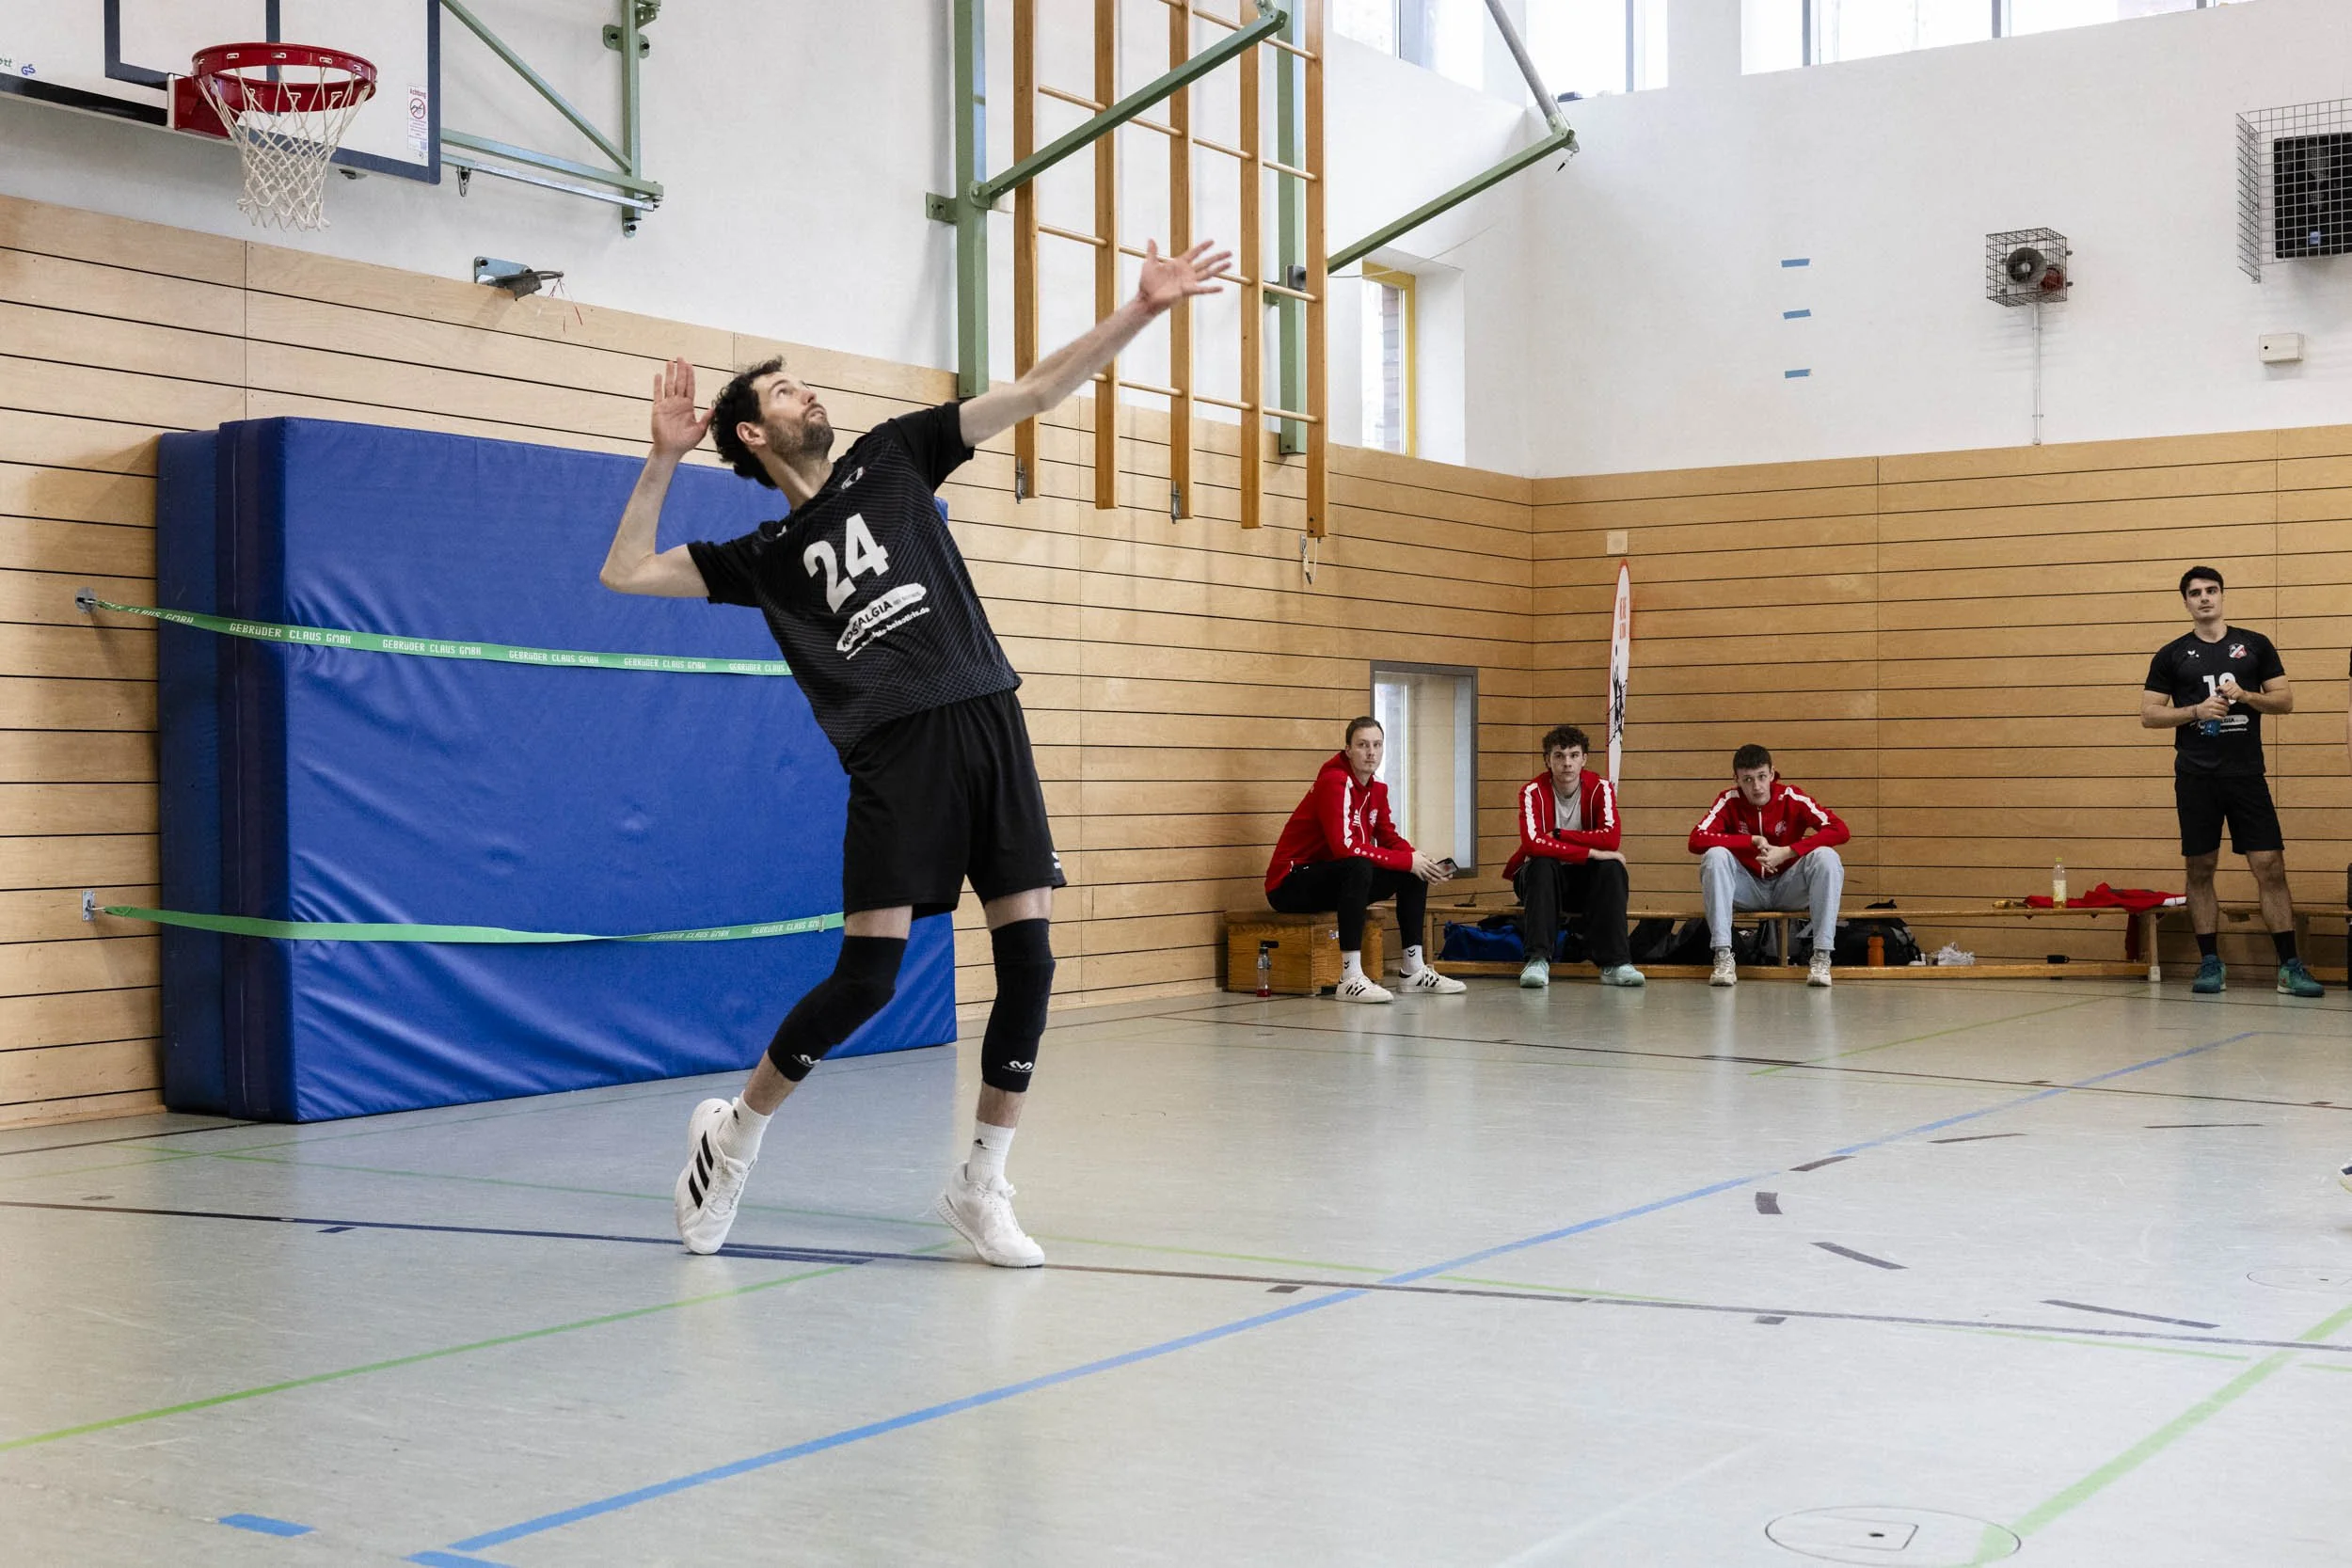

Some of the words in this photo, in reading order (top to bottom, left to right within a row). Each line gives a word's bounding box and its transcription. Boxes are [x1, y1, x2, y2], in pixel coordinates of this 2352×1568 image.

[803, 513, 890, 614] 24
[841, 600, 894, 648] NOSTALGIA
[289, 629, 322, 641] CLAUS
[326, 633, 351, 644] GMBH
[429, 643, 455, 654] CLAUS
[459, 646, 482, 656] GMBH
[551, 654, 576, 663] CLAUS
[579, 655, 599, 664] GMBH
[662, 659, 685, 669] CLAUS
[687, 661, 707, 670] GMBH
[764, 663, 785, 672] CLAUS
[786, 922, 806, 930] CLAUS
